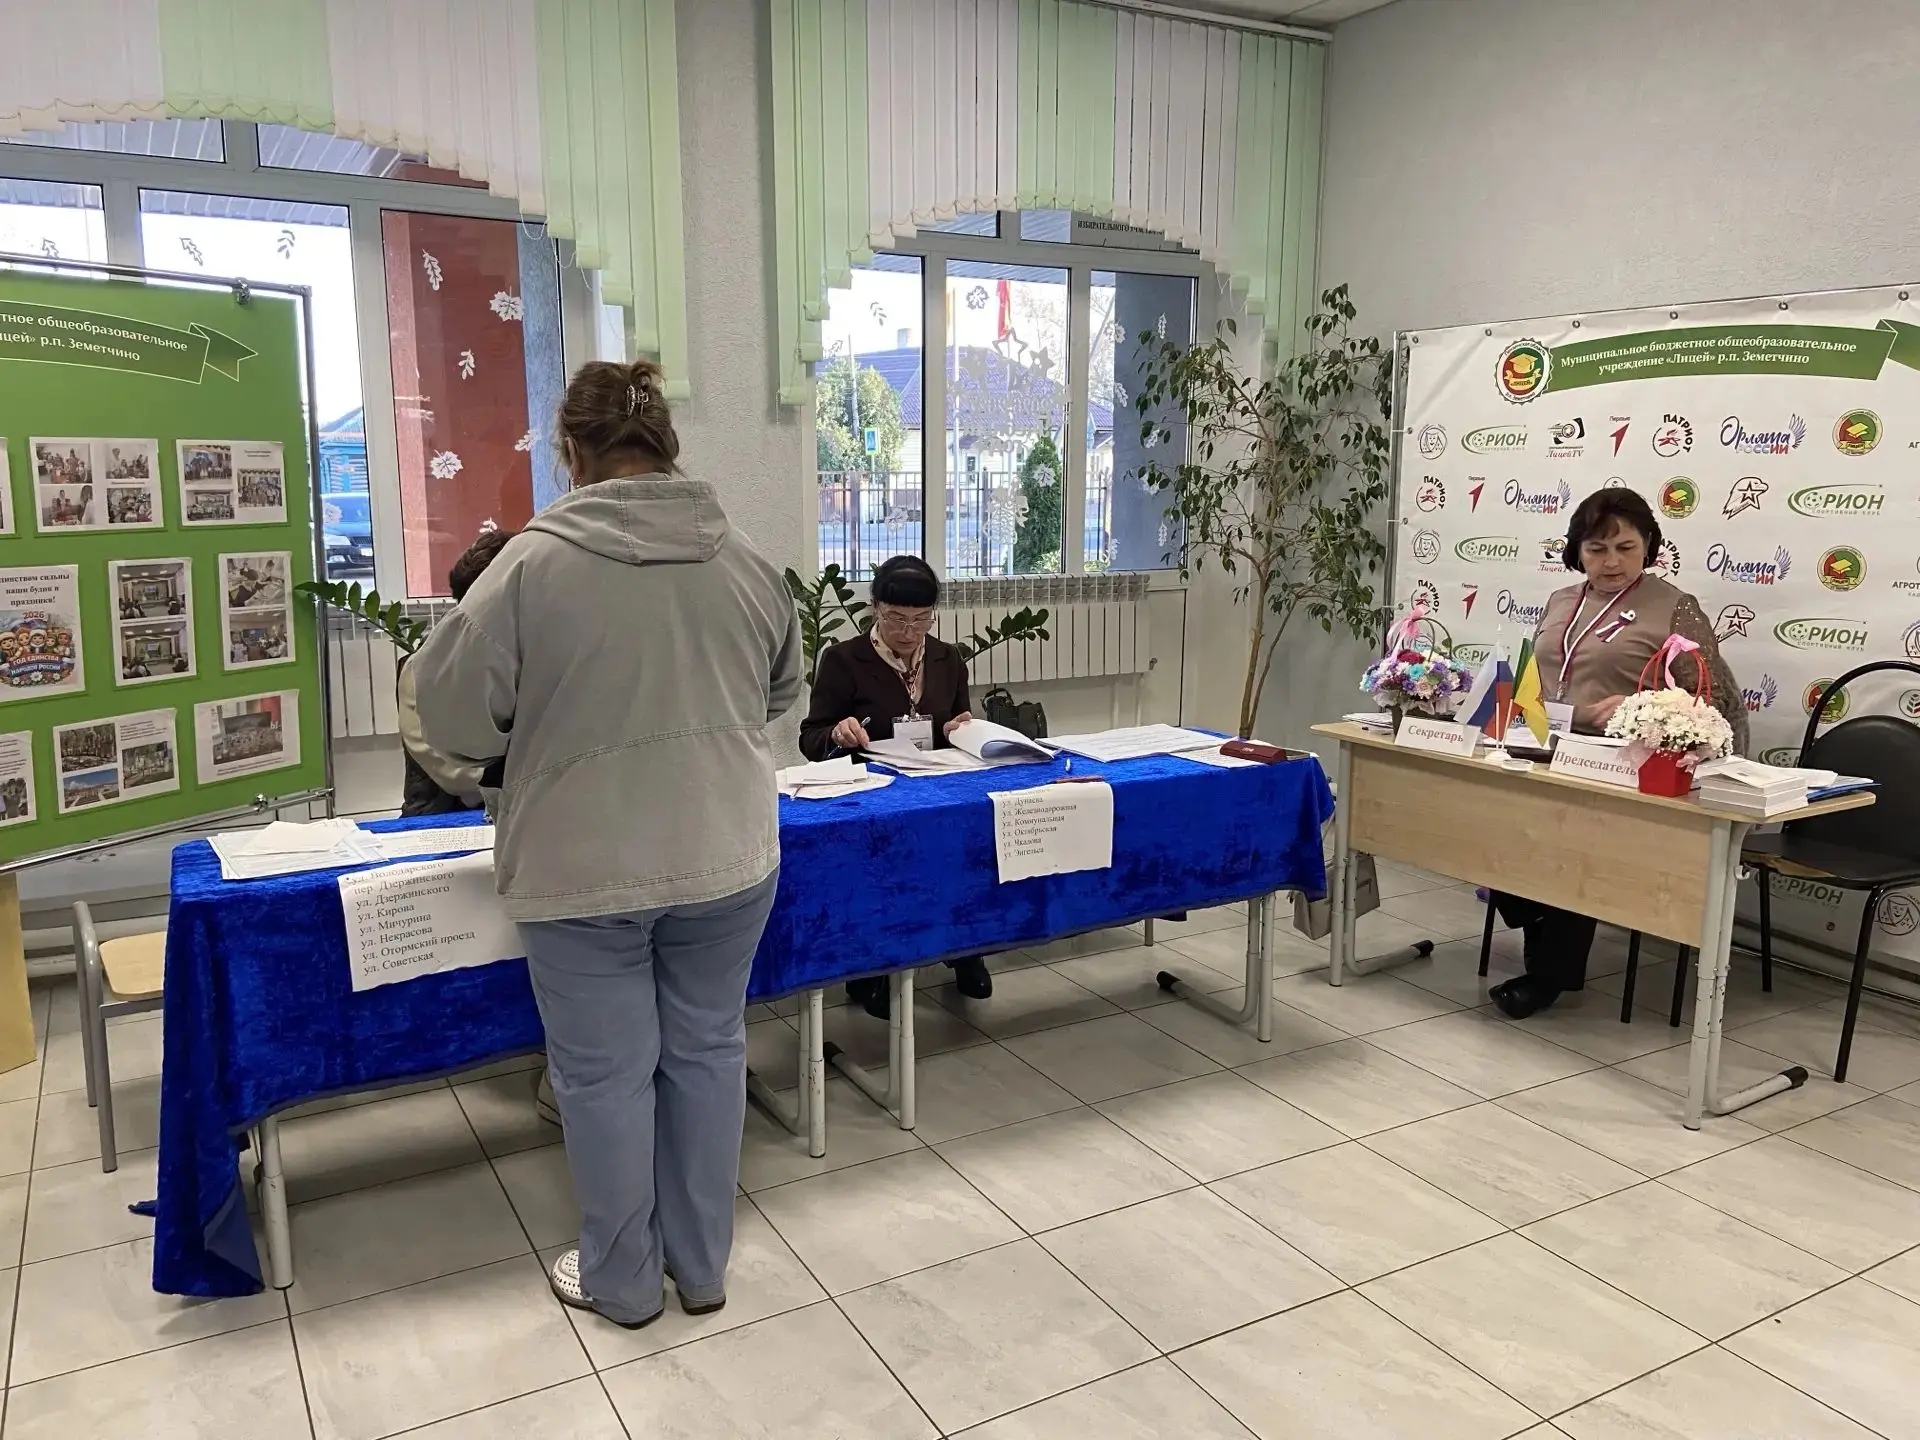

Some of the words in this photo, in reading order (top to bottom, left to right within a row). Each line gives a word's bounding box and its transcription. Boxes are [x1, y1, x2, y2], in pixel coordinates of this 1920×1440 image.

[37, 316, 188, 351] общеобразовательное
[40, 336, 65, 348] р.п.
[68, 338, 140, 361] Земетчино
[1560, 345, 1649, 368] Муниципальное
[1649, 339, 1716, 353] бюджетное
[1717, 335, 1857, 353] общеобразовательное
[1598, 357, 1665, 375] учреждение
[1665, 352, 1715, 365] «Лицей»
[1717, 353, 1740, 365] р.п.
[1742, 351, 1810, 364] Земетчино
[1663, 413, 1694, 453] ПАТРИОТ
[1720, 415, 1791, 449] Орлята
[1736, 443, 1789, 455] РОССИИ
[1423, 475, 1446, 510] ПАТРИОТ
[1504, 478, 1560, 508] Орлята
[1659, 538, 1681, 577] АТРИОТ
[1706, 543, 1777, 577] Орлята
[1721, 572, 1775, 586] РОССИИ
[1417, 579, 1440, 613] ПАТРИОТ
[1497, 589, 1543, 618] Орлят
[23, 611, 45, 620] 2026
[1407, 725, 1464, 744] Секретарь
[1553, 750, 1637, 777] Председатель
[354, 885, 376, 896] пер.
[379, 871, 455, 892] Дзержинского
[355, 898, 373, 910] ул.
[374, 885, 451, 906] Дзержинского
[357, 911, 374, 923] ул.
[376, 903, 415, 919] Кирова
[359, 924, 376, 936] ул.
[378, 913, 432, 932] Мичурина
[361, 938, 377, 950] ул.
[380, 926, 433, 945] Некрасова
[362, 951, 378, 963] ул.
[380, 936, 438, 957] Отормский
[440, 930, 476, 946] проезд
[363, 964, 380, 976] ул.
[382, 951, 435, 970] Советская
